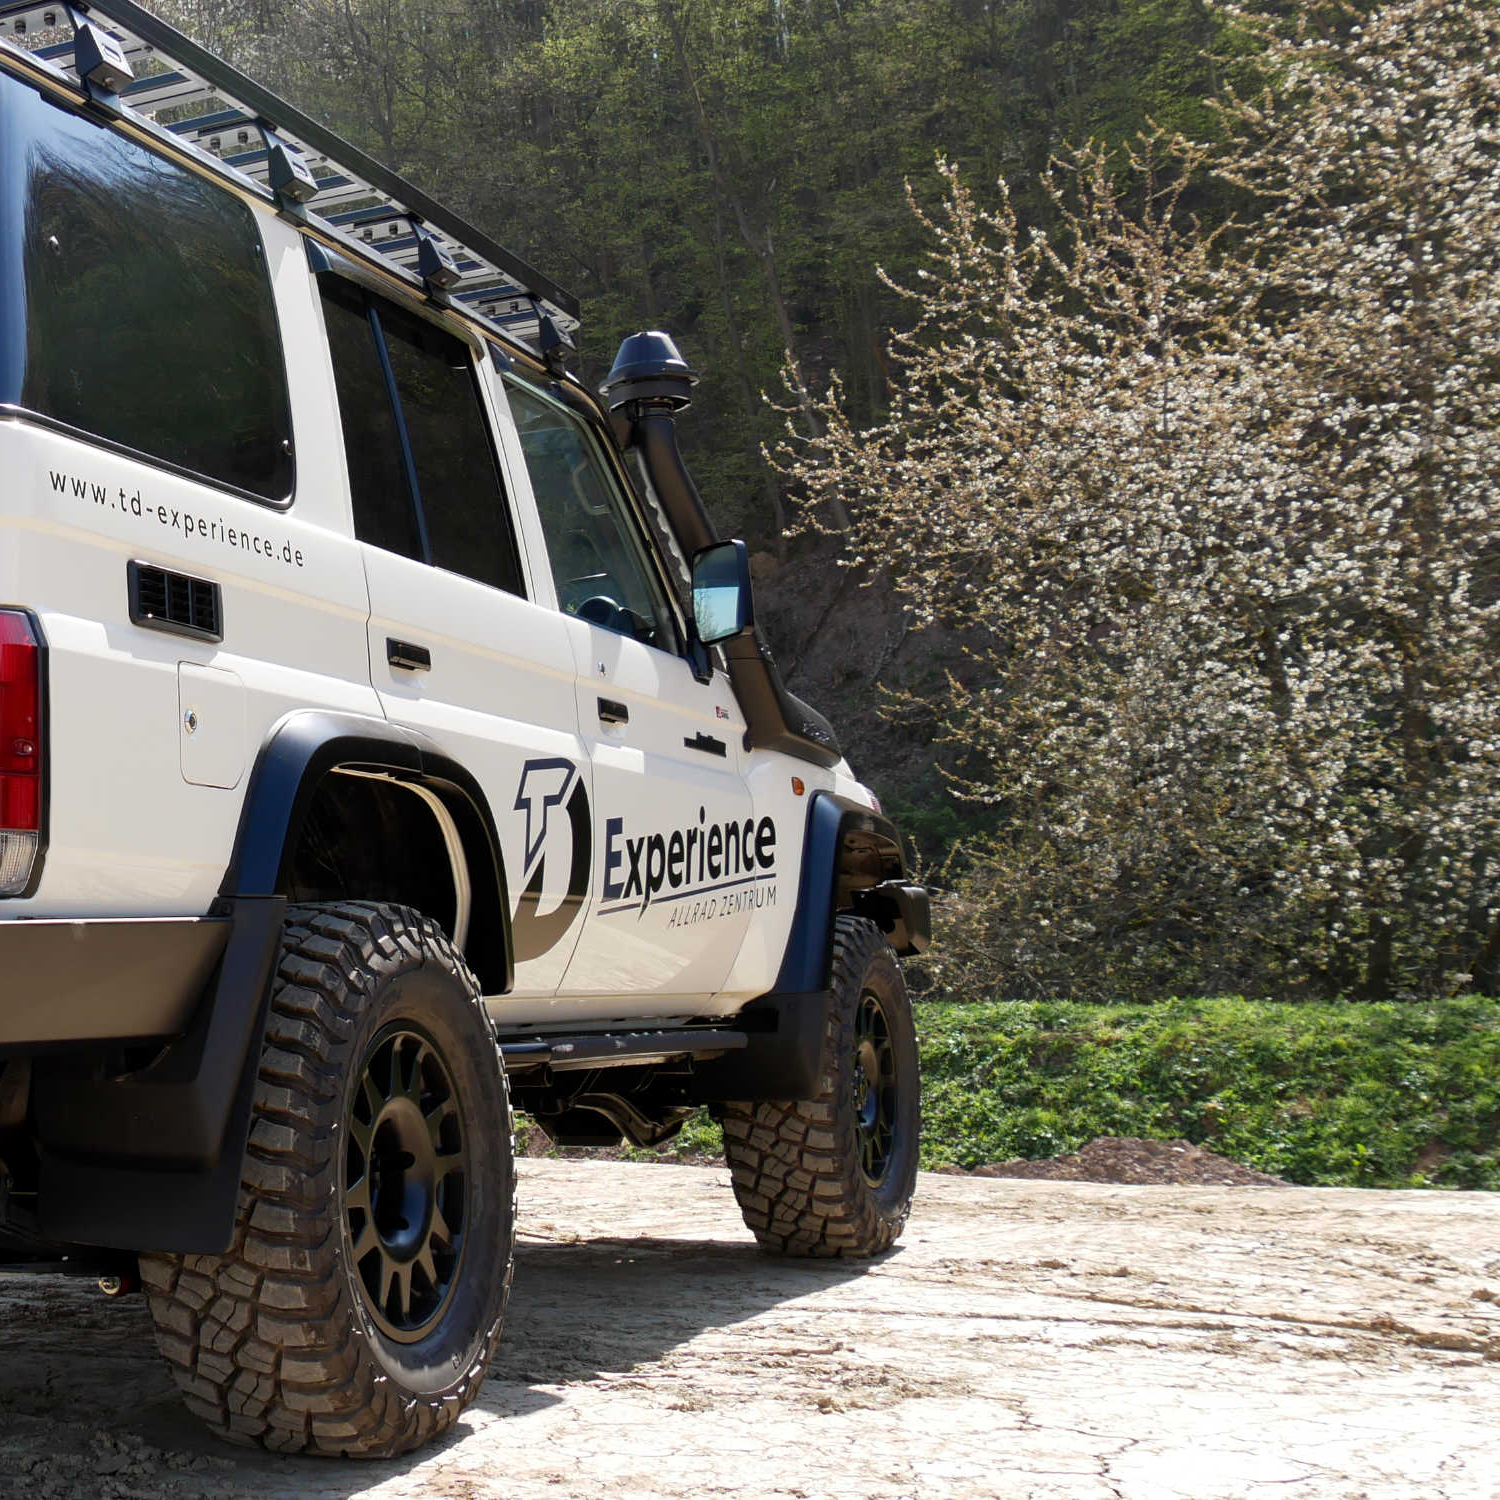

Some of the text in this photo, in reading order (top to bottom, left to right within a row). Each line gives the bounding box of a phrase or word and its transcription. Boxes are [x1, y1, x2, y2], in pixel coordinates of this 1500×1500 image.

[49, 469, 304, 567] www.td-experience.de
[600, 805, 777, 922] Experience
[667, 885, 777, 930] ALLRAD ZENTRUM
